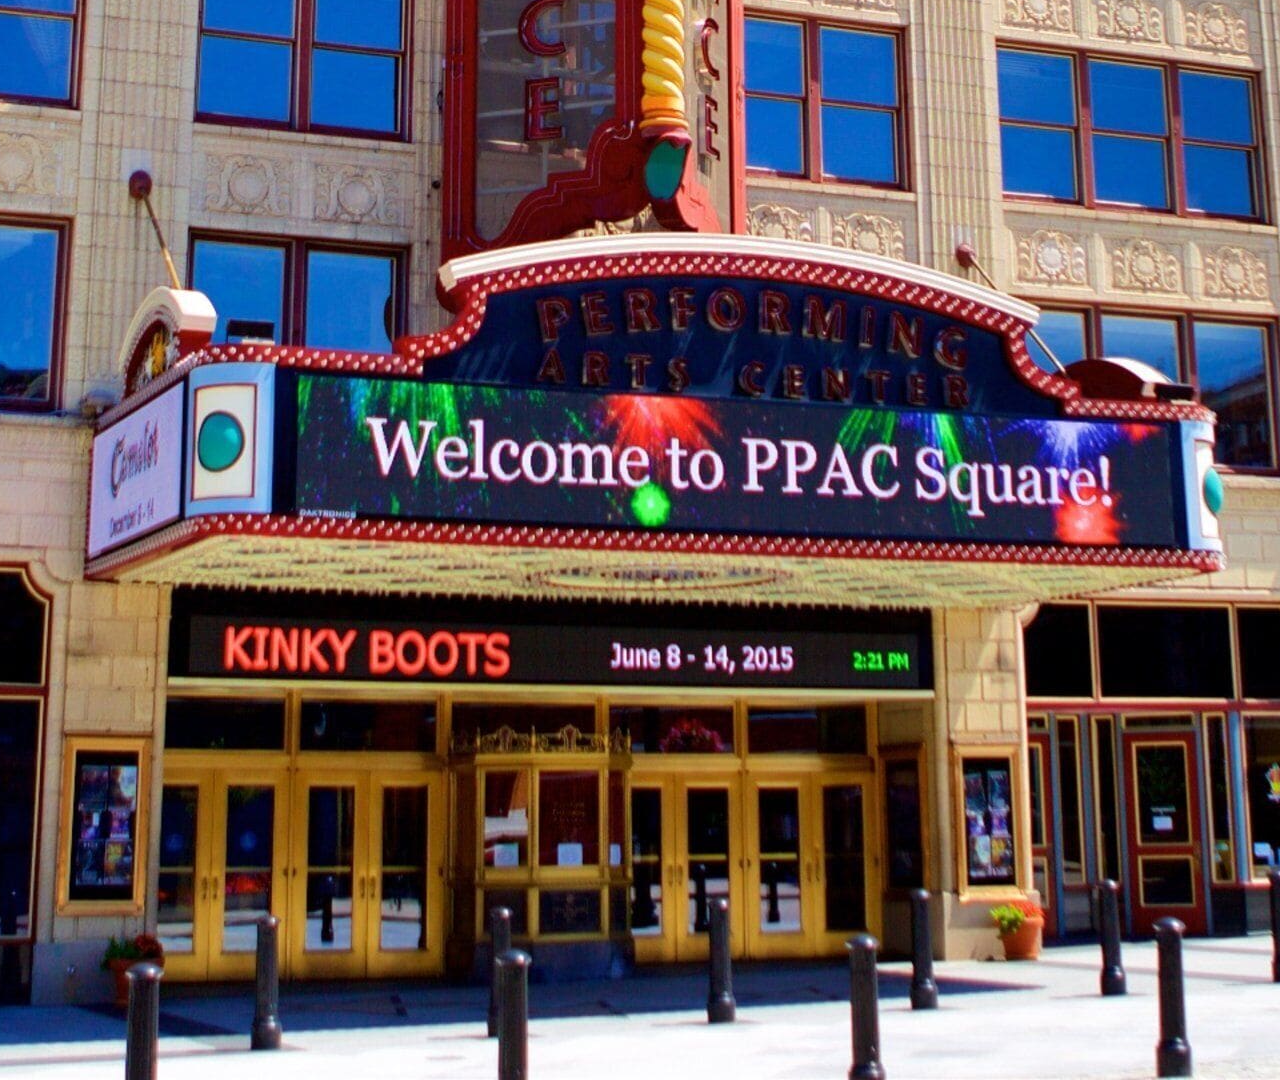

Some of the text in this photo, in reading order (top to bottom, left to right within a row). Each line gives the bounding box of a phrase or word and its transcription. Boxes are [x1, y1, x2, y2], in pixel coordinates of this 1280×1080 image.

[537, 288, 970, 371] PERFORMING
[537, 347, 970, 409] ARTS CENTER
[111, 421, 159, 498] Camelot
[366, 416, 1113, 517] Welcome to PPAC Square!
[298, 508, 357, 519] DAKTRONICS
[225, 625, 511, 677] KINKY BOOTS
[611, 642, 662, 669] June
[666, 644, 681, 669] 8
[703, 645, 736, 674] 14,
[741, 646, 794, 671] 2015
[853, 651, 910, 670] 2:21 PM
